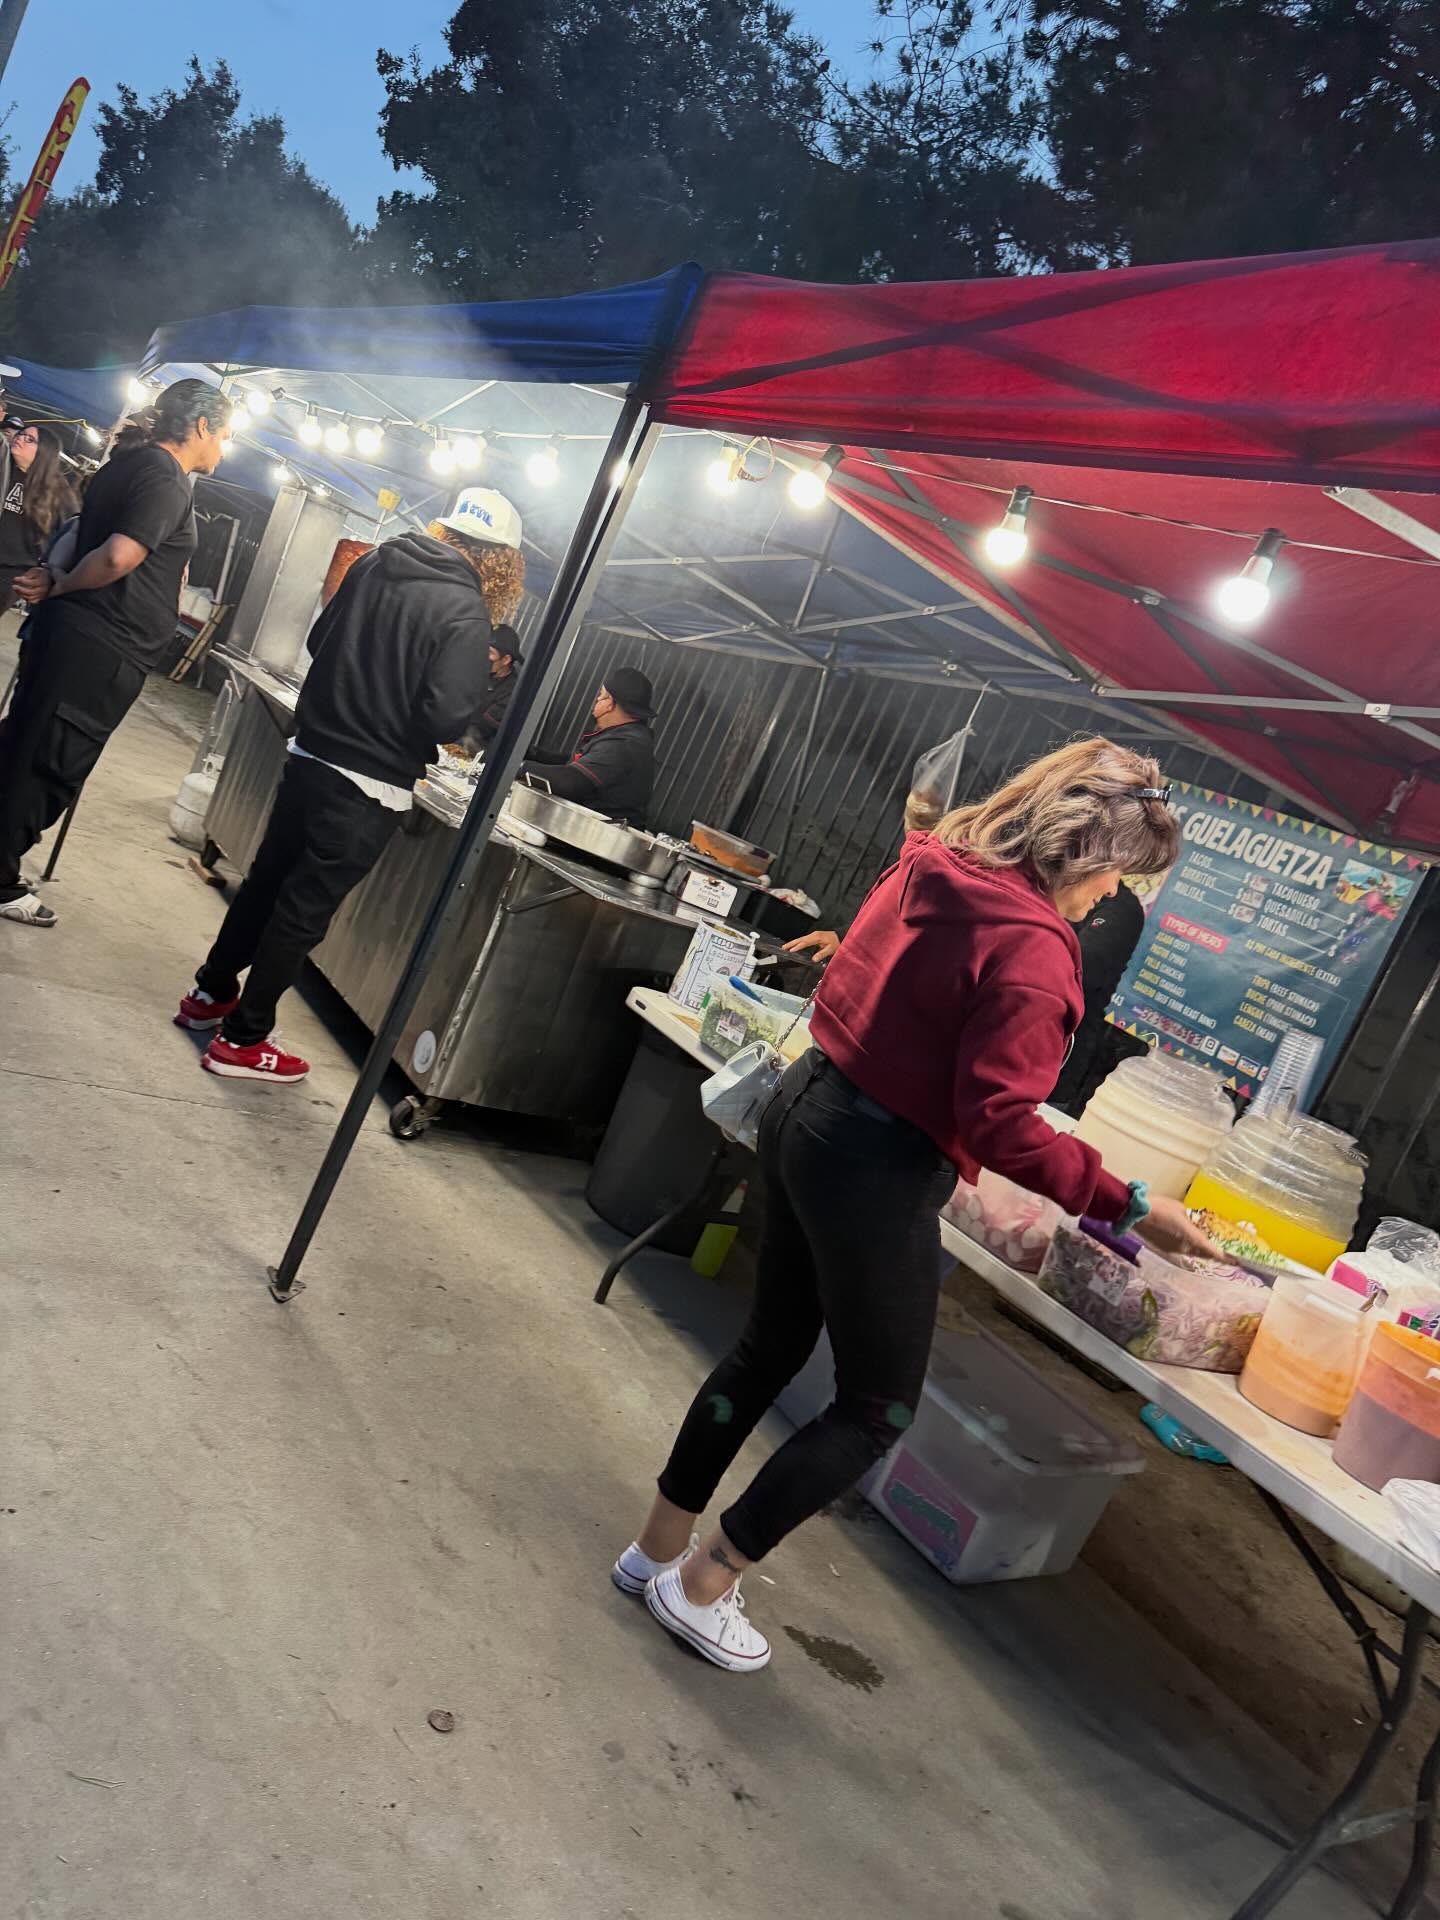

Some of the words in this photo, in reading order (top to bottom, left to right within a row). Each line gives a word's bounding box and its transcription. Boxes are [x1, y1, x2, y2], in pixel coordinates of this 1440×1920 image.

[1182, 812, 1335, 890] GUELAGUETZA
[1189, 851, 1214, 868] TACOS
[1180, 866, 1217, 889] BURRITOS
[1174, 881, 1206, 902] MULITAS
[1272, 882, 1320, 911] TACOQUESO
[1263, 899, 1320, 930] QUESADILLAS
[1166, 916, 1188, 933] TYPES
[1186, 926, 1200, 937] OF
[1197, 930, 1223, 949] MEATS
[1257, 915, 1289, 937] TORTAS
[1314, 968, 1341, 987] (EXTRA)
[1287, 991, 1320, 1012] STOMACH)
[1283, 1006, 1317, 1028] STOMACH)
